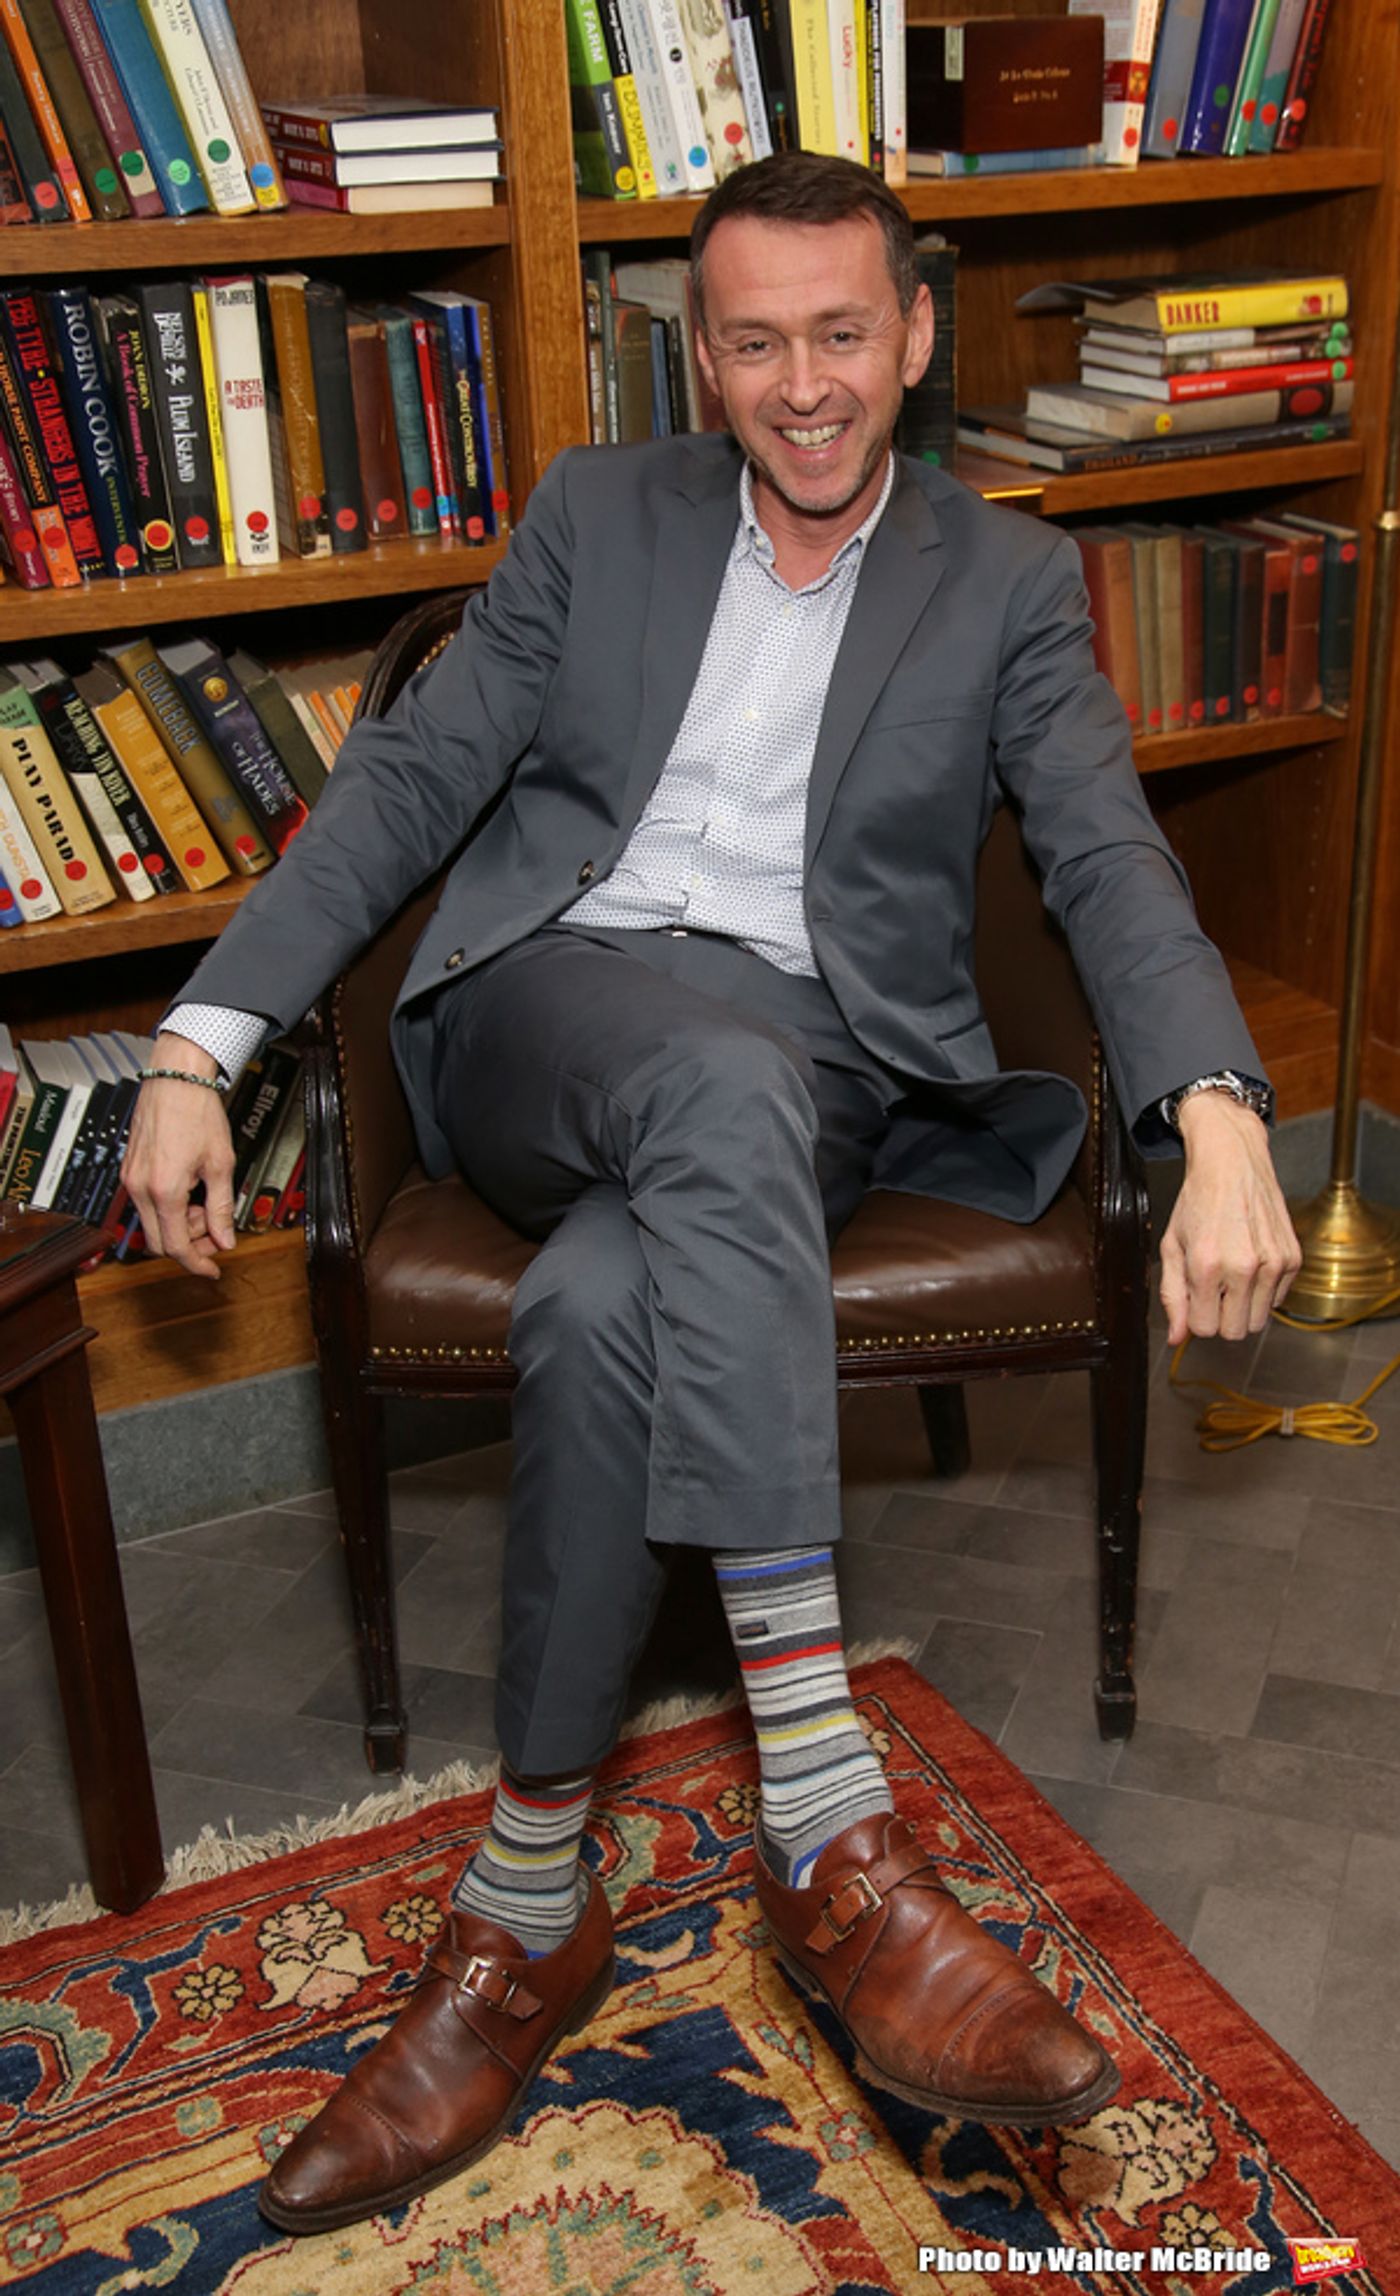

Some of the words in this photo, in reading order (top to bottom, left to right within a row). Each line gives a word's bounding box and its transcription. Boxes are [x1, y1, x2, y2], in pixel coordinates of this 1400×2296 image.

[584, 11, 603, 63] FARM
[9, 297, 36, 326] PEG
[169, 312, 187, 360] NELSON
[16, 328, 48, 370] TYRE
[118, 344, 133, 377] Book
[129, 330, 142, 357] JOAN
[154, 312, 175, 361] DEMILLE
[64, 302, 100, 392] ROBIN
[84, 396, 117, 478] COOK
[125, 379, 136, 395] of
[134, 358, 150, 410] DIDION
[224, 380, 232, 394] A
[233, 378, 263, 394] TASTE
[235, 394, 265, 410] DEATH
[457, 380, 470, 412] GREAT
[0, 362, 17, 404] HORSE
[11, 407, 29, 442] PAINT
[21, 445, 47, 503] COMPANY
[29, 378, 74, 463] STRANGERS
[126, 396, 144, 453] Common
[168, 394, 195, 432] PLUM
[54, 464, 80, 484] IN
[173, 431, 198, 483] ISLAND
[459, 414, 476, 488] CONTROVERSY
[59, 482, 89, 515] THE
[135, 456, 151, 499] Prayer
[106, 476, 127, 546] INTERVENTI
[136, 661, 201, 757] COMEBACK
[11, 737, 42, 788] PLAY
[36, 793, 76, 862] PARAD
[237, 755, 281, 818] HADES
[257, 747, 297, 808] HOUSE
[241, 1083, 280, 1141] Ellroy
[14, 1147, 42, 1181] Leo
